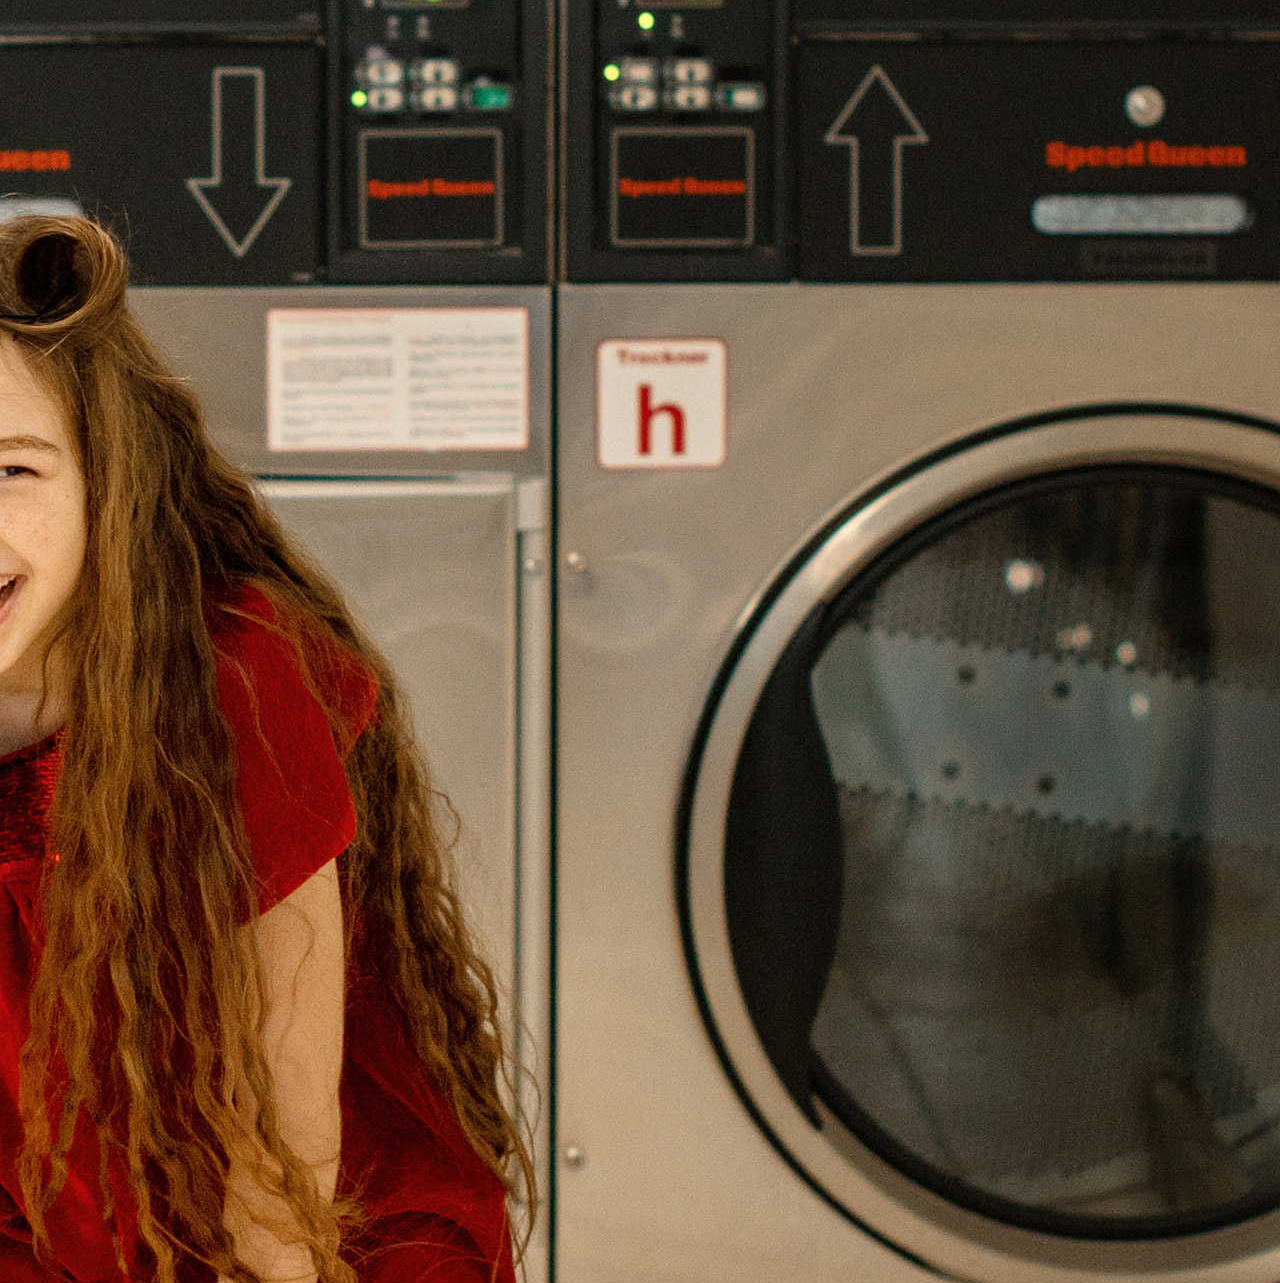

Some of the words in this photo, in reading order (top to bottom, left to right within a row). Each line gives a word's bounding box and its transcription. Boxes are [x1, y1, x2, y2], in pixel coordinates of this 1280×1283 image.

[1046, 141, 1145, 172] Speed
[1148, 140, 1247, 167] Queen
[636, 383, 687, 457] h
